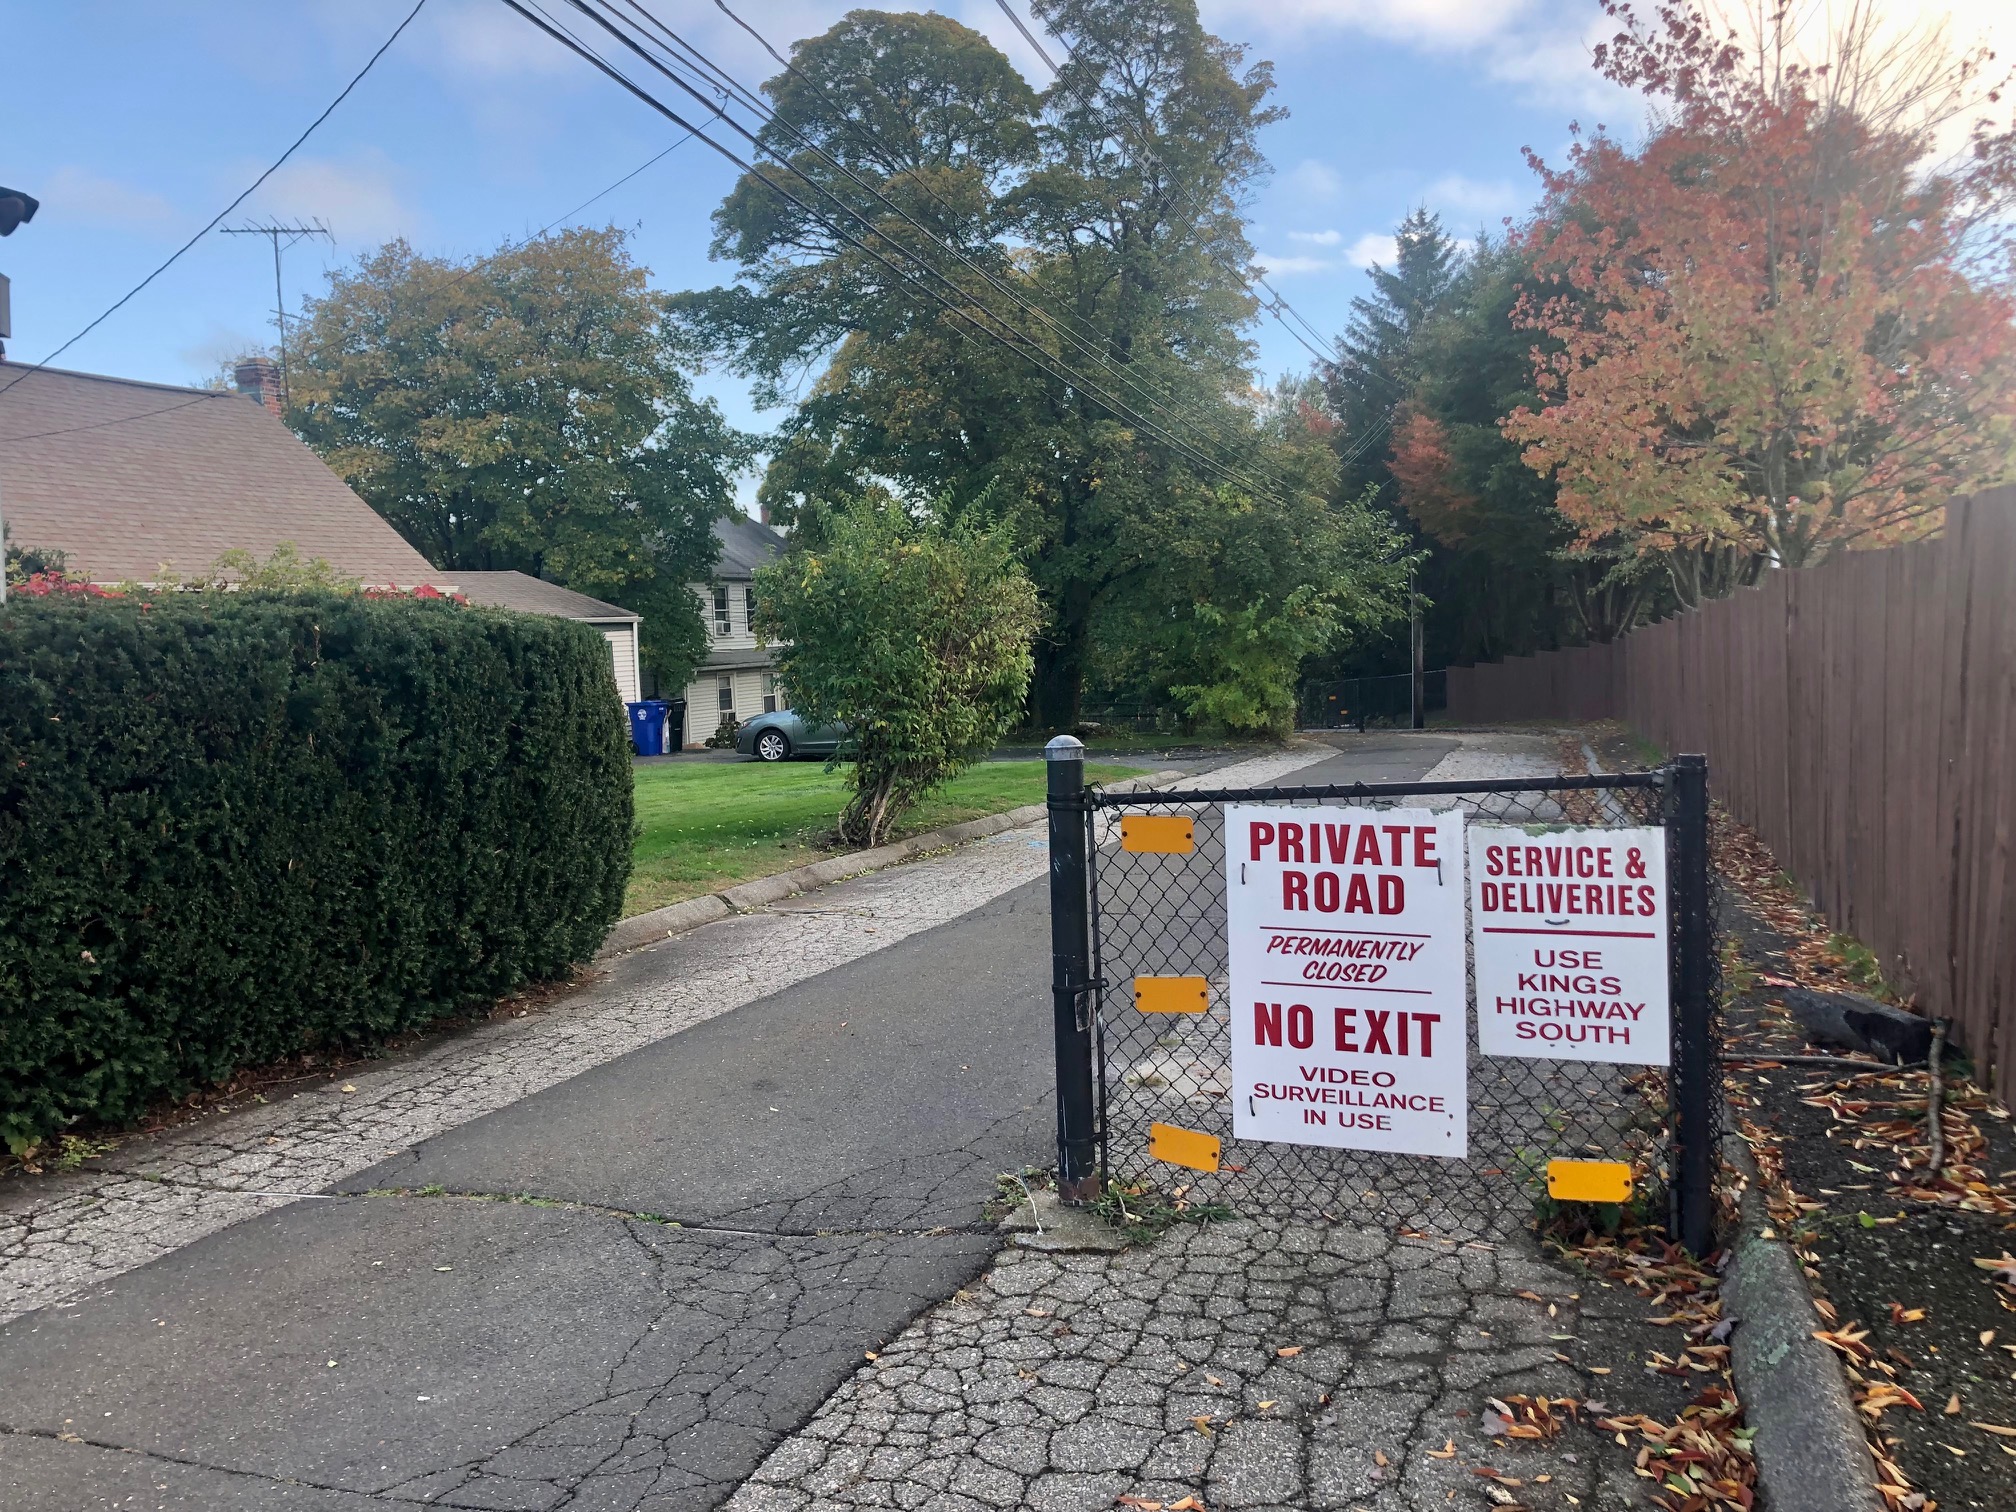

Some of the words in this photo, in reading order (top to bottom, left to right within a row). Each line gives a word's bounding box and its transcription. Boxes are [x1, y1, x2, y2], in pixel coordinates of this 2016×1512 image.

[1249, 821, 1439, 868] PRIVATE
[1485, 845, 1614, 878] SERVICE
[1624, 847, 1647, 879] &
[1282, 870, 1406, 916] ROAD
[1480, 882, 1656, 917] DELIVERIES
[1266, 935, 1425, 962] PERMANENTLY
[1533, 949, 1603, 970] USE
[1301, 961, 1388, 983] CLOSED
[1517, 973, 1622, 996] KINGS
[1495, 997, 1646, 1021] HIGHWAY
[1253, 1002, 1314, 1050] NO
[1334, 1007, 1441, 1058] EXIT
[1514, 1021, 1631, 1045] SOUTH
[1298, 1065, 1396, 1088] VIDEO
[1253, 1082, 1445, 1113] SURVEILLANCE
[1303, 1108, 1326, 1126] IN
[1338, 1111, 1392, 1131] USE
